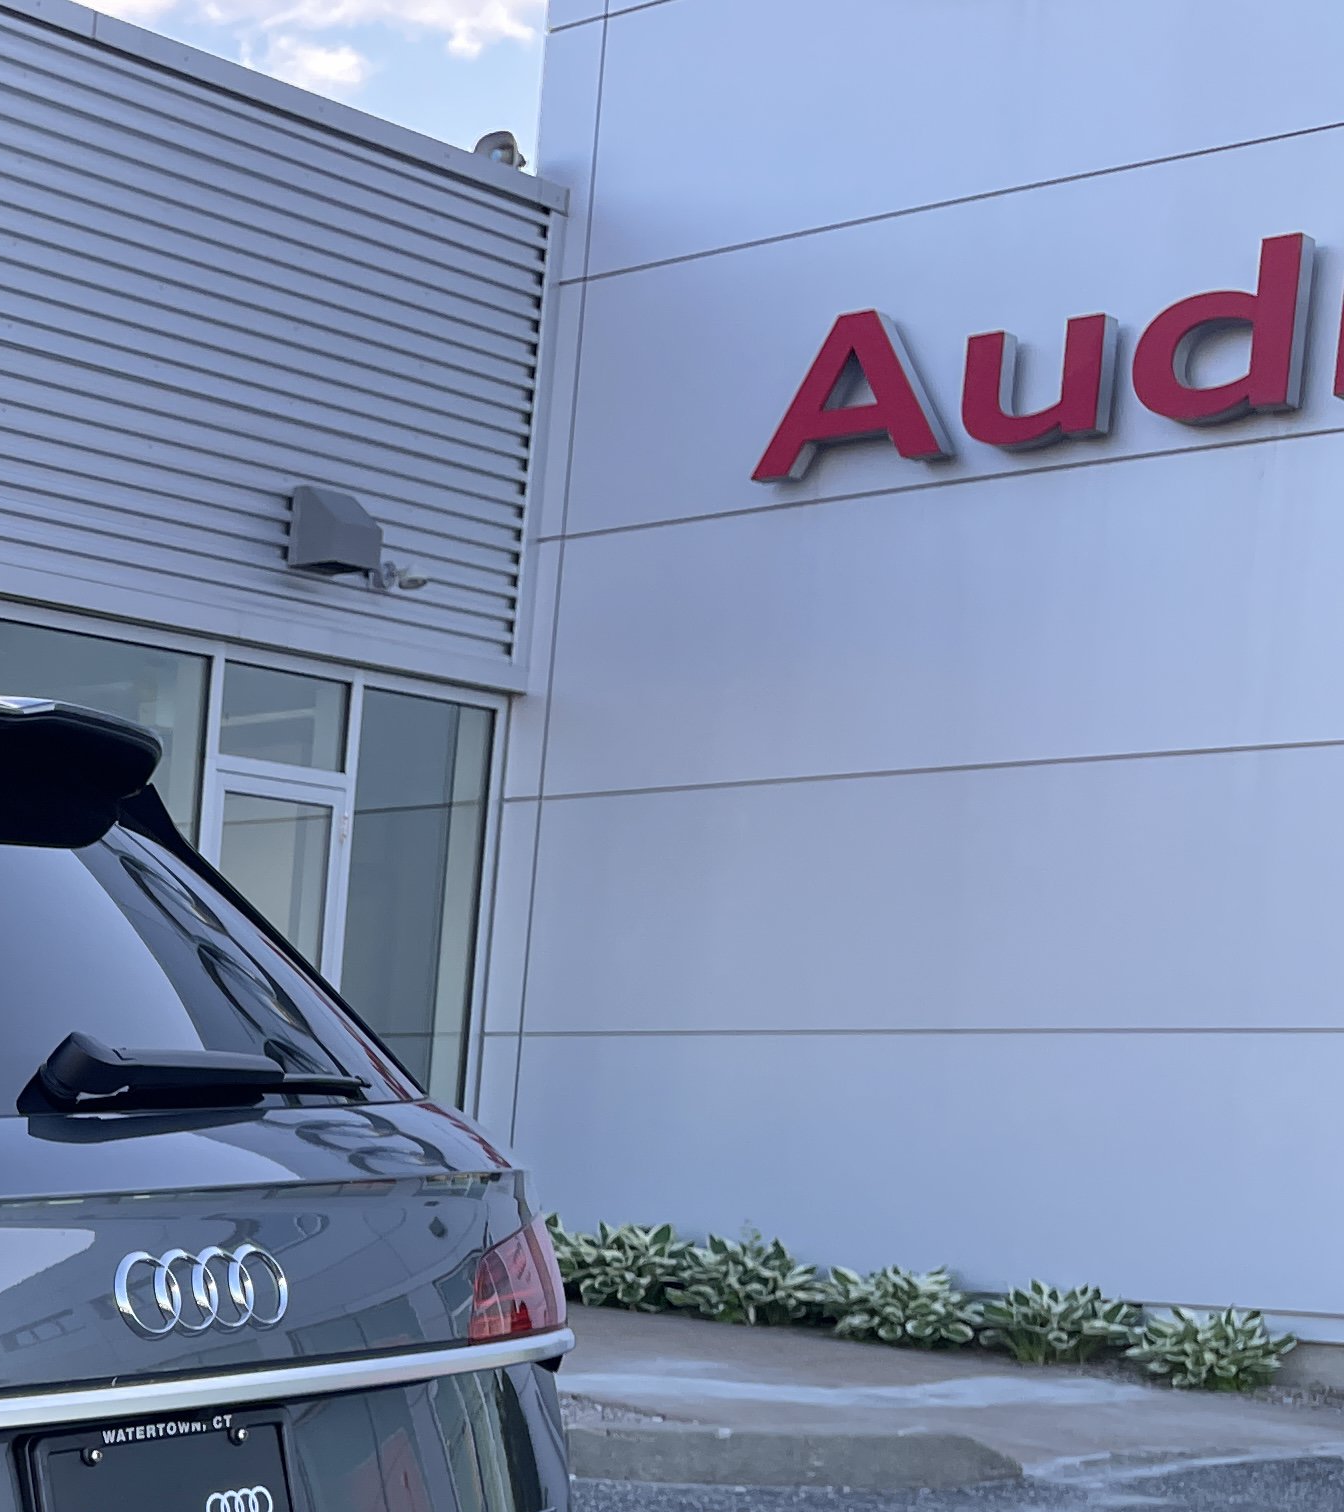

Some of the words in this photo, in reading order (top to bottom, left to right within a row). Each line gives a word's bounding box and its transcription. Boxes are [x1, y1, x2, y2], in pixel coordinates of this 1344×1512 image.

[751, 232, 1344, 482] Aud
[102, 1420, 208, 1445] WATERTOWN,
[212, 1414, 234, 1430] CT
